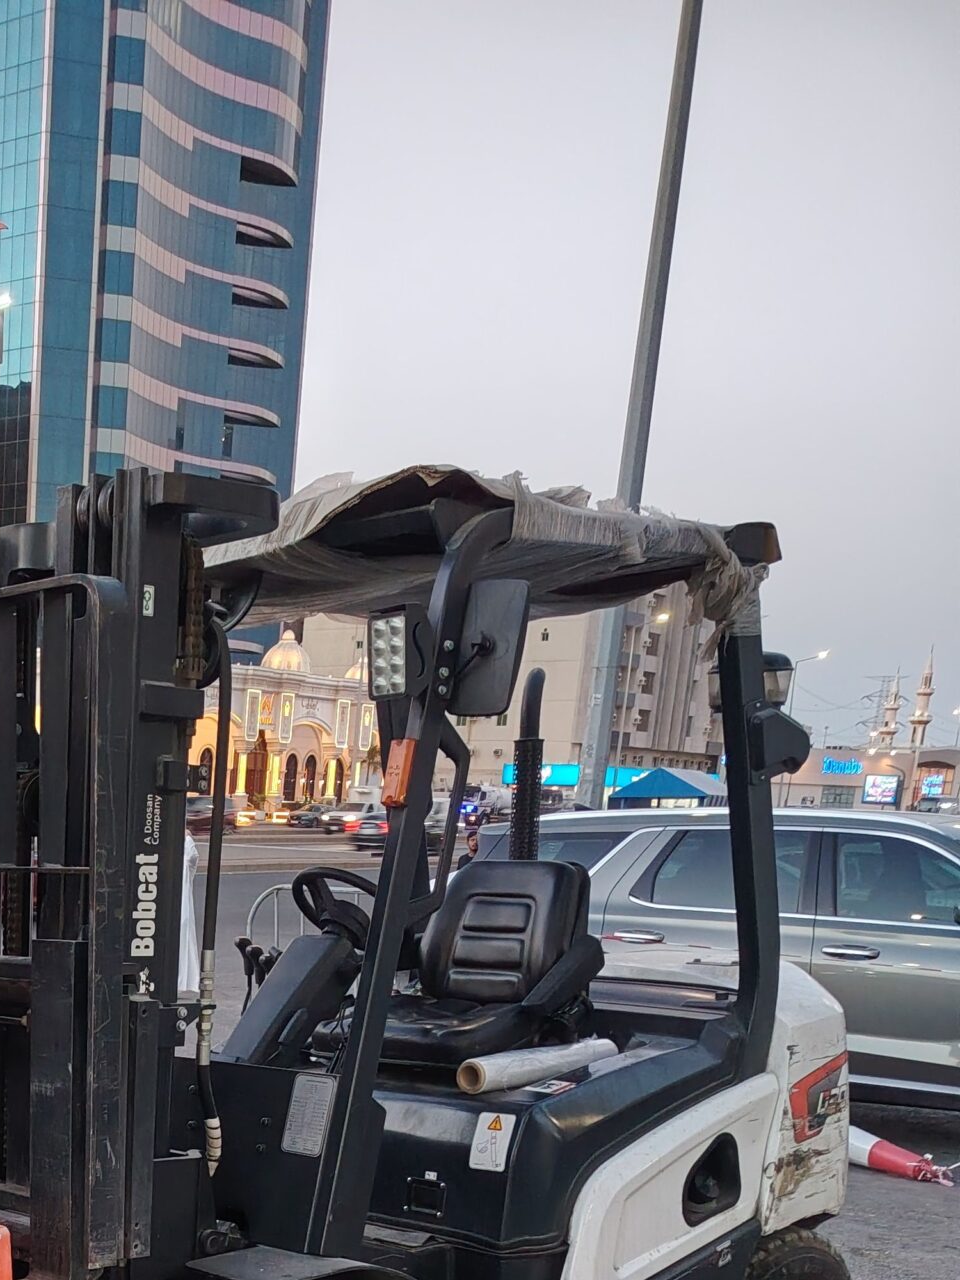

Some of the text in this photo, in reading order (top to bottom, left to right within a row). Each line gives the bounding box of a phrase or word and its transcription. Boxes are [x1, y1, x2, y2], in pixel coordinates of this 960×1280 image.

[144, 794, 153, 832] Doosan
[151, 795, 162, 845] Company
[131, 853, 159, 957] Bobcat
